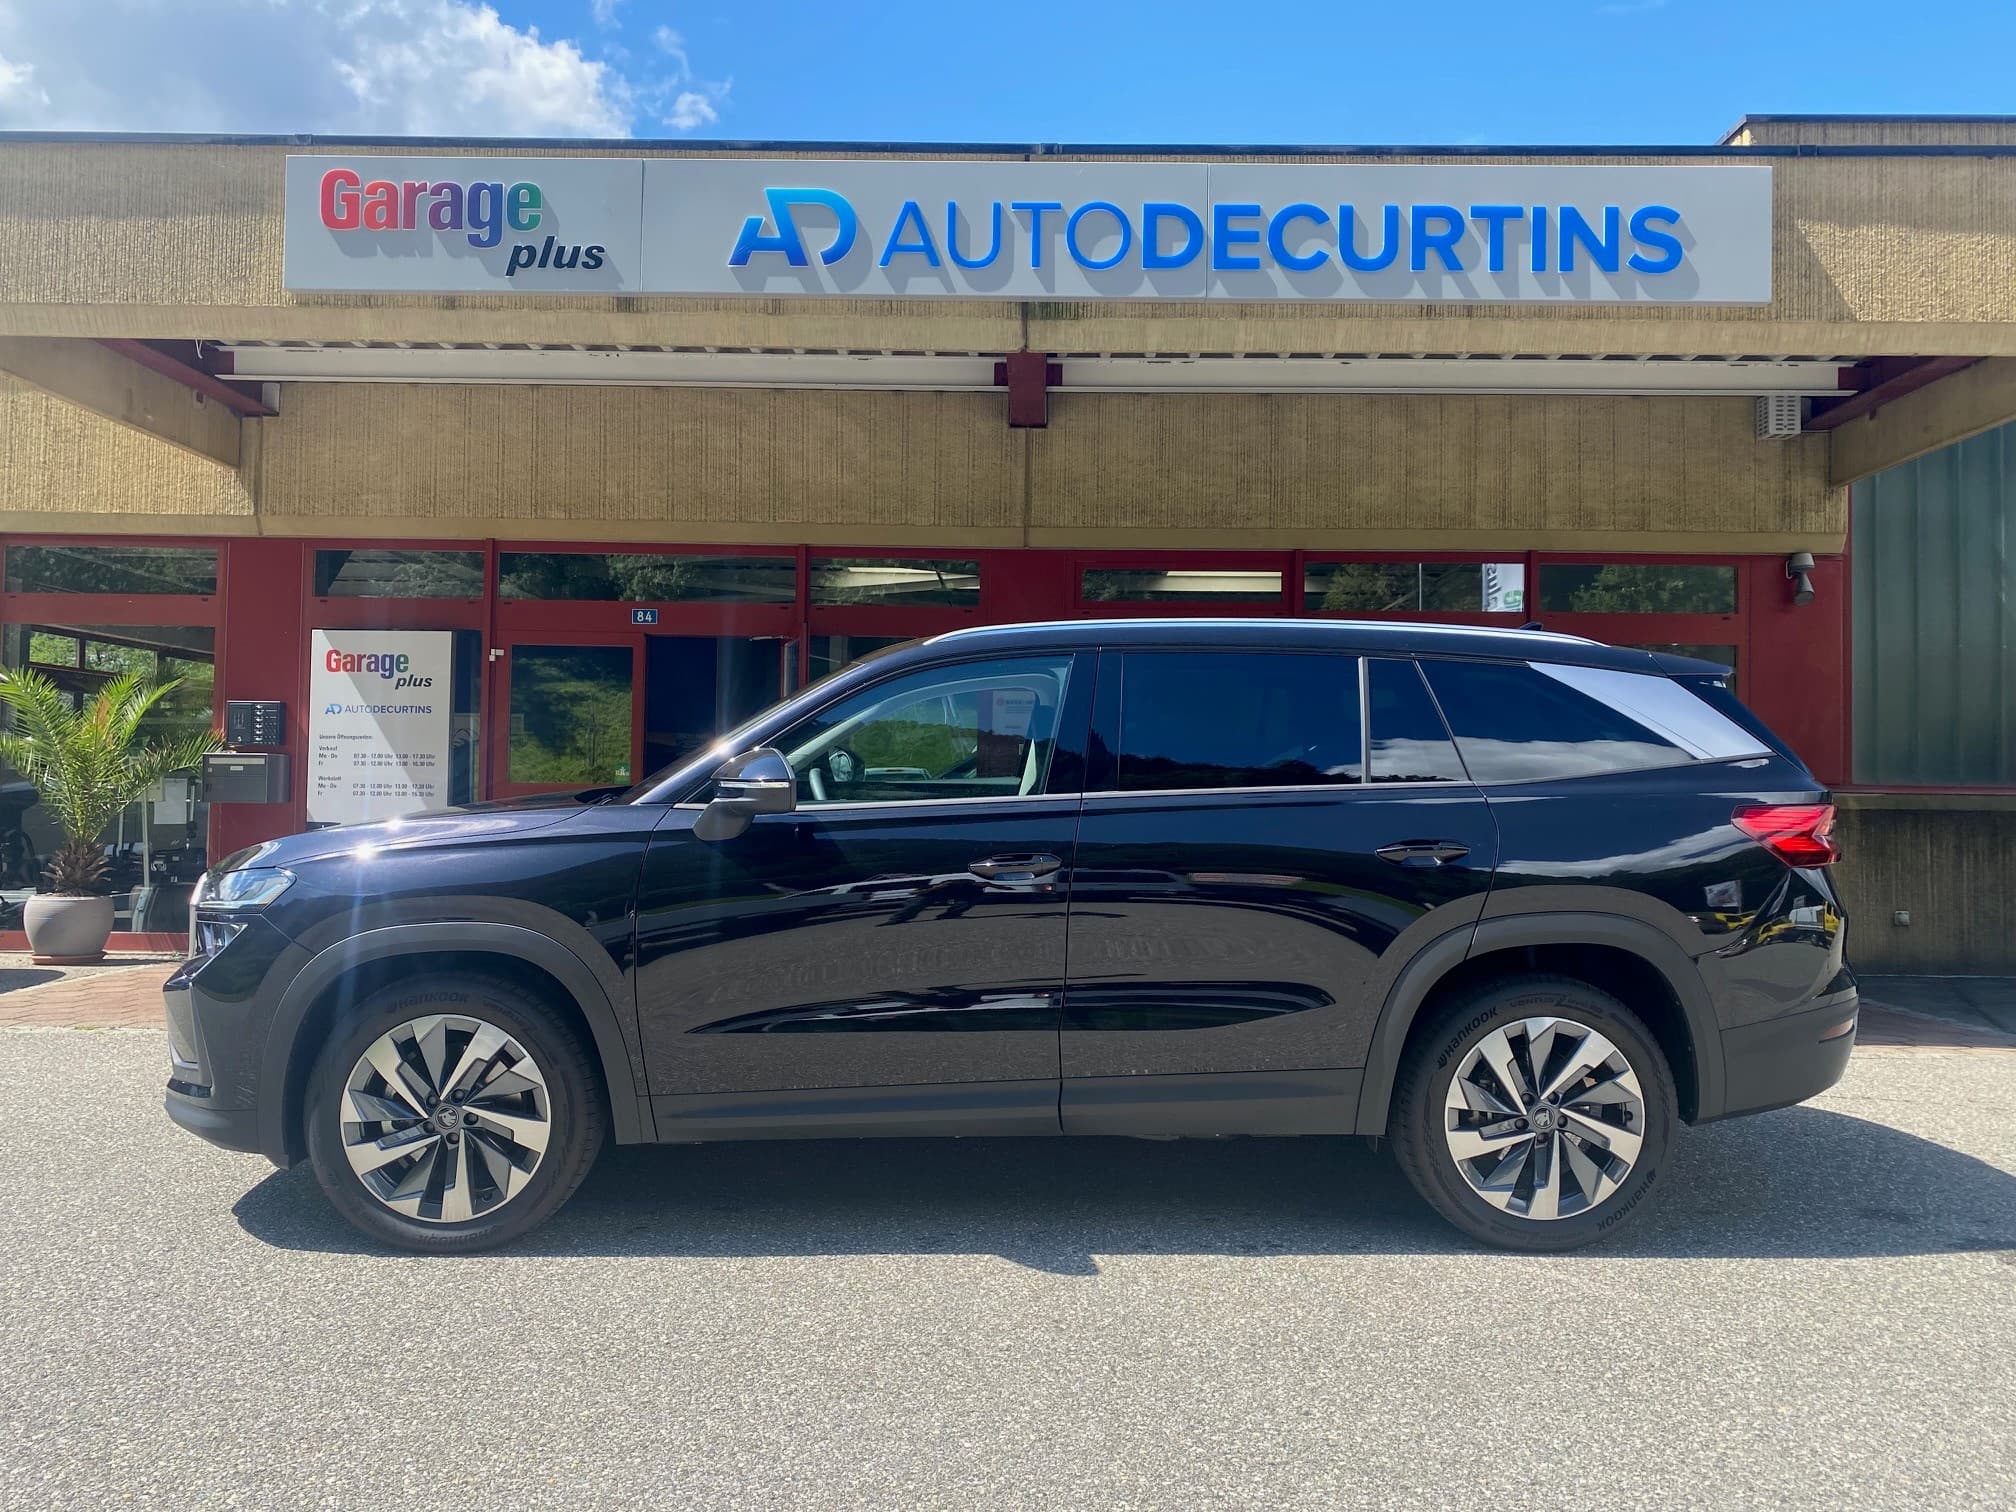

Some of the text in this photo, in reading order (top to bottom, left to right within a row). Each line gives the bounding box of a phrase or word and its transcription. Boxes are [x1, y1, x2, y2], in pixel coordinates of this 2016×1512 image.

[319, 168, 543, 249] Garage
[878, 200, 1685, 275] AUTODECURTINS
[505, 235, 606, 277] plus
[637, 611, 653, 622] 84
[326, 649, 409, 679] Garage
[395, 674, 433, 690] plus
[344, 705, 432, 714] AUTODECURTINS
